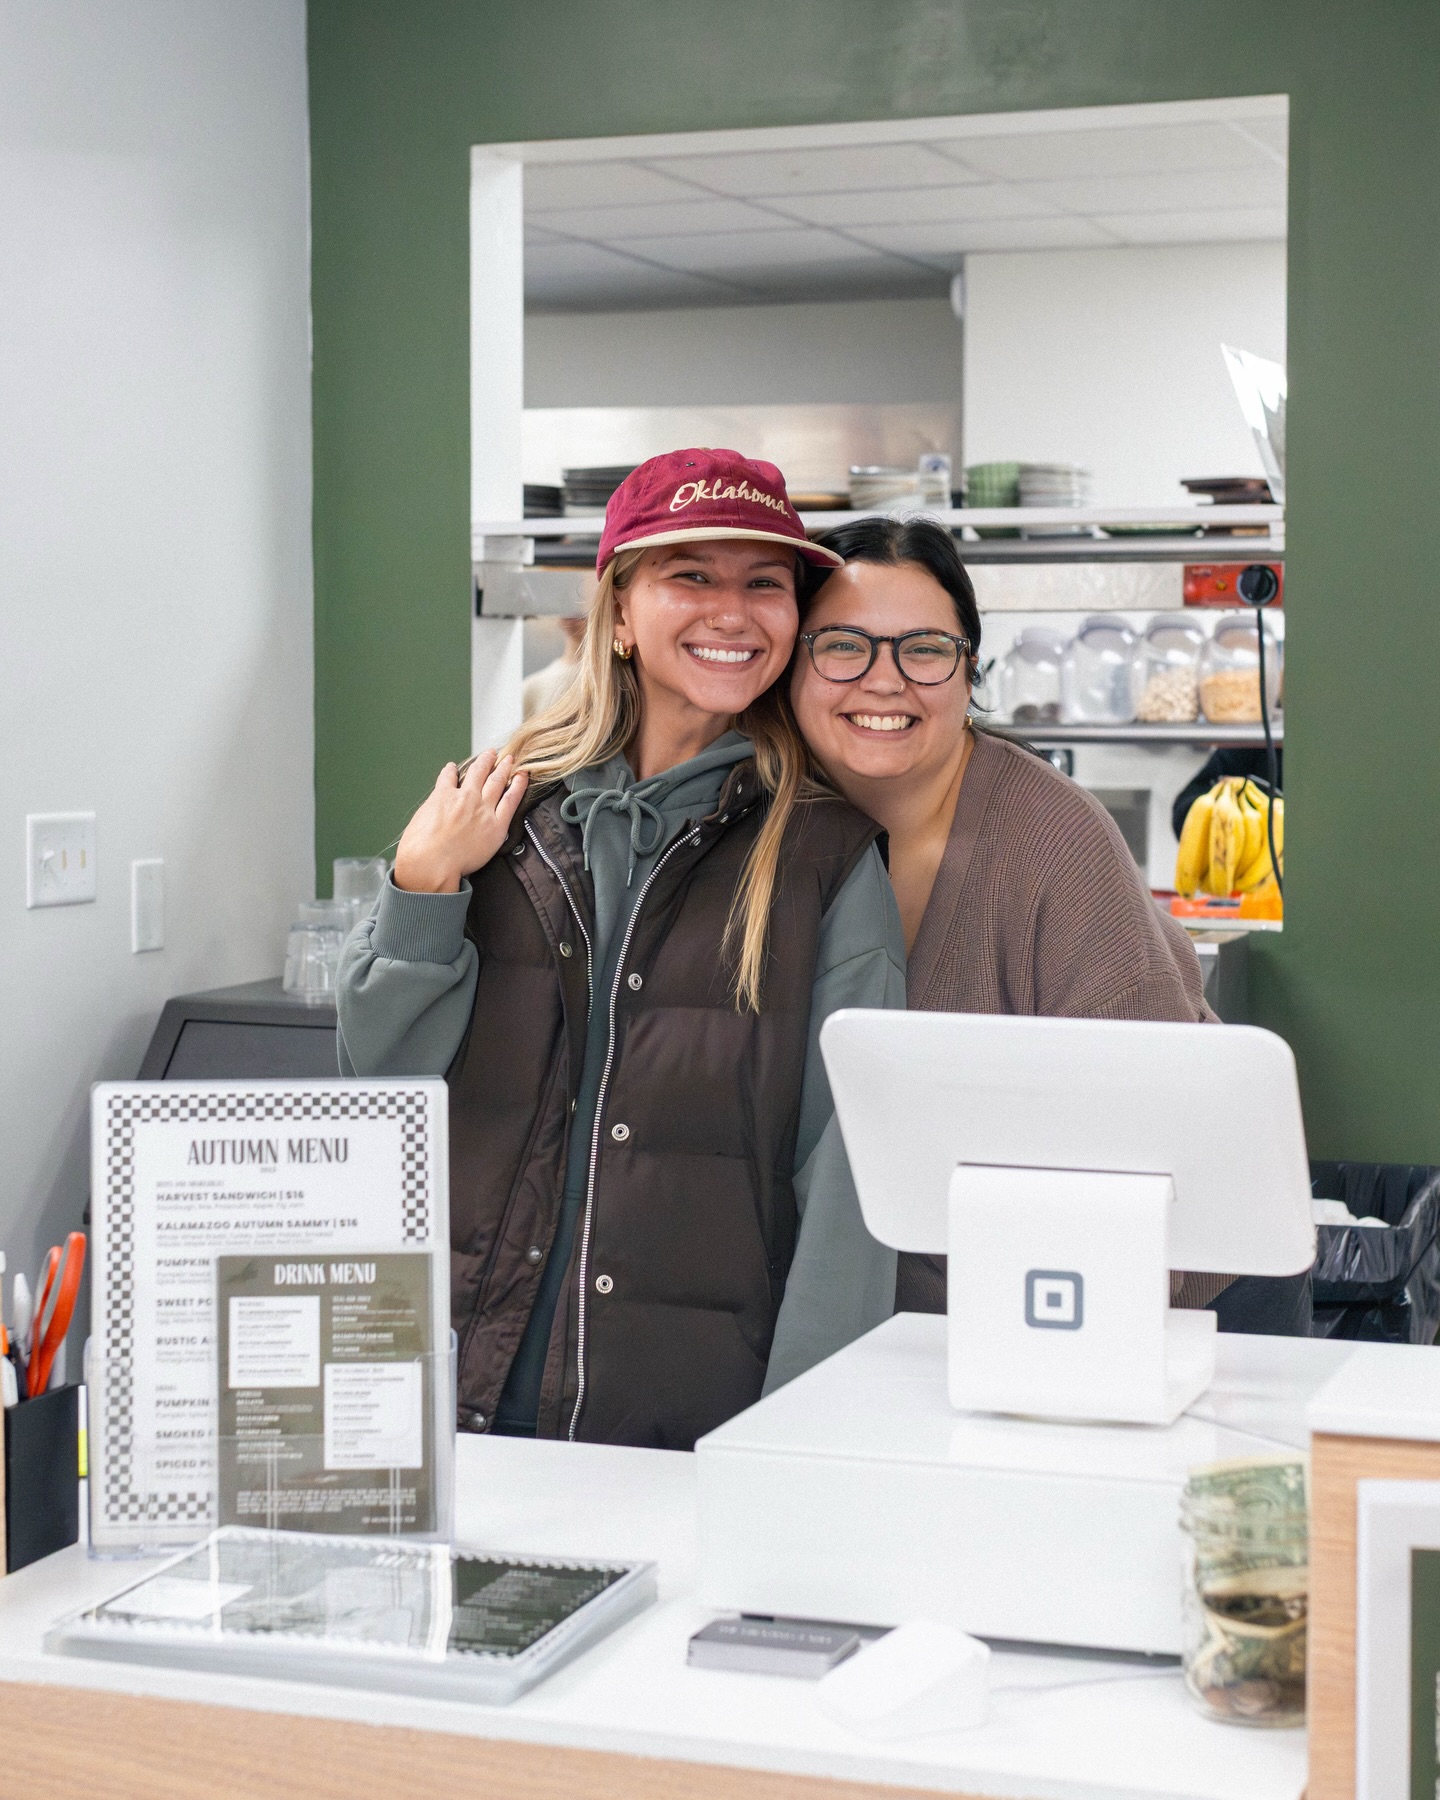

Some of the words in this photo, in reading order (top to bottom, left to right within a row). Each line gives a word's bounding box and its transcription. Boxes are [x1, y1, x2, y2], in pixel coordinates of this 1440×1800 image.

[669, 478, 791, 519] Oklahoma
[188, 1139, 279, 1165] AUTUMN
[287, 1137, 349, 1163] MENU
[157, 1192, 210, 1202] HARVEST
[213, 1191, 277, 1201] SANDWICH
[157, 1221, 232, 1231] KALAMAZOO
[234, 1219, 285, 1230] AUTUMN
[287, 1219, 331, 1229] SAMMY
[157, 1258, 210, 1267] PUMPKIN
[274, 1263, 326, 1285] DRINK
[330, 1262, 377, 1284] MENU
[157, 1298, 195, 1308] SWEET
[157, 1336, 198, 1346] RUSTIC
[156, 1399, 210, 1408] PUMPKIN
